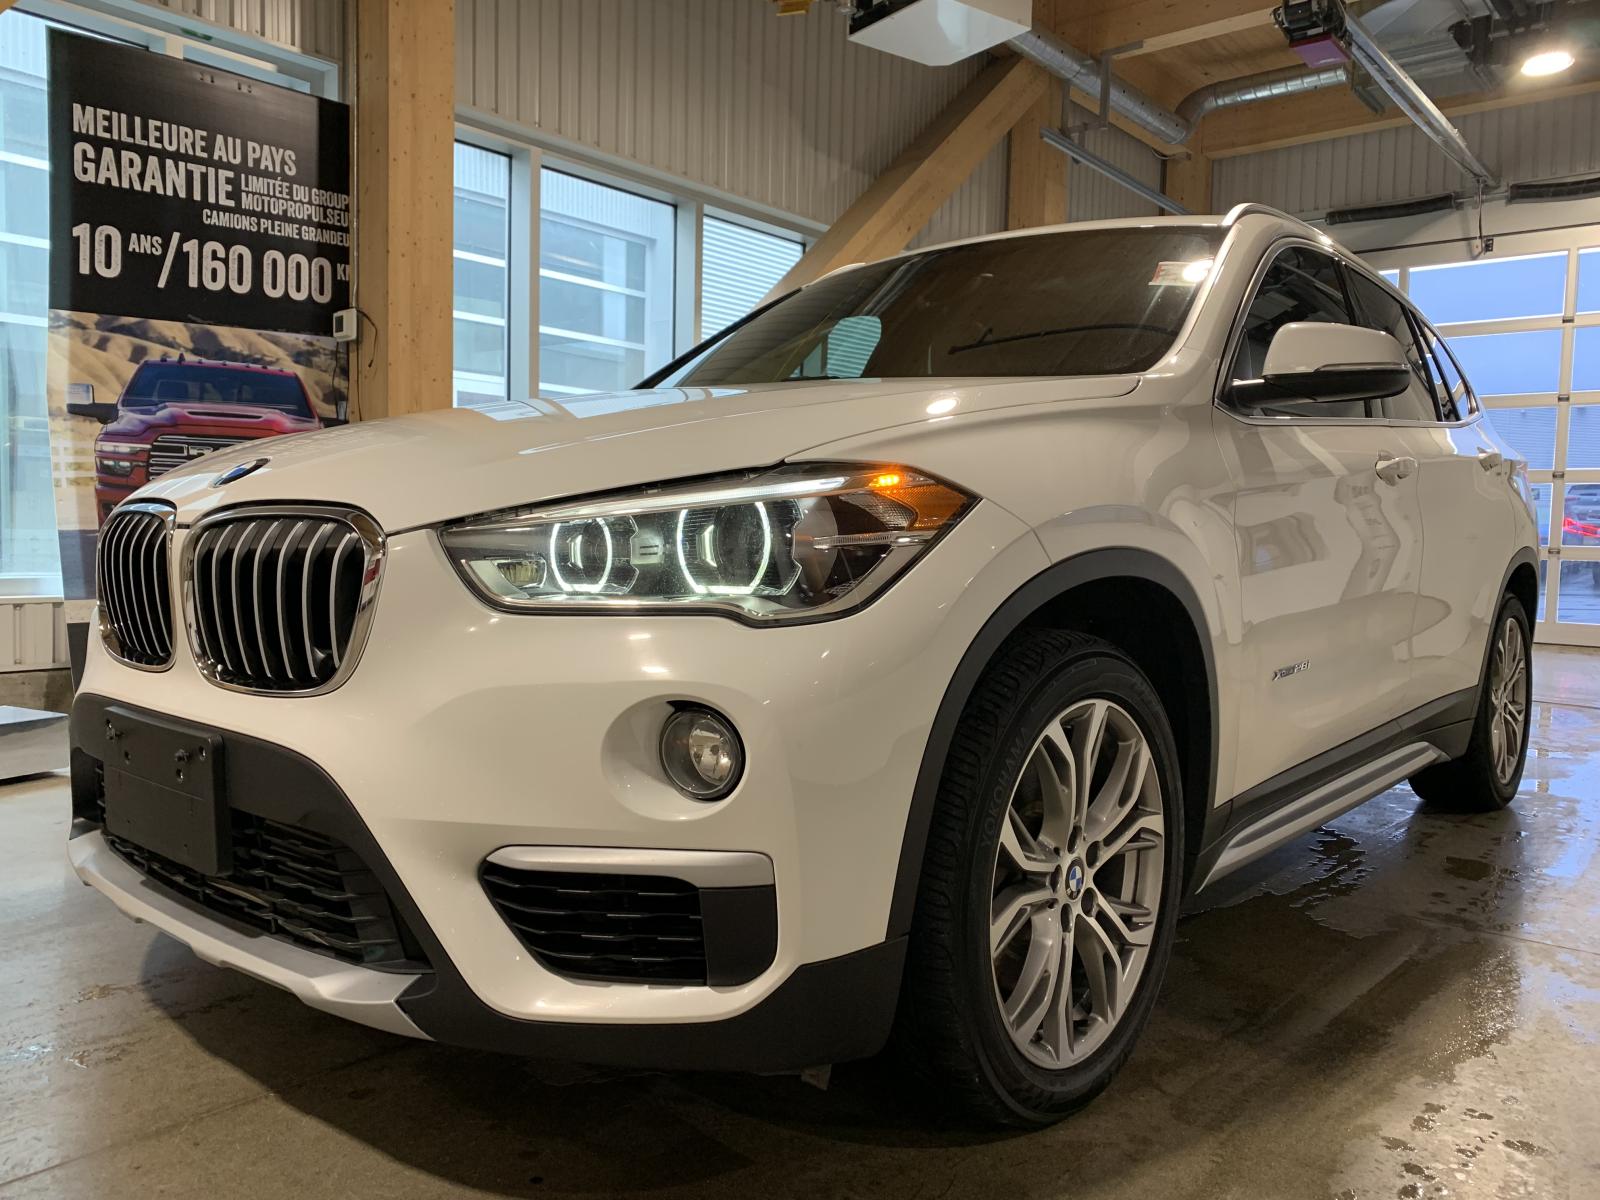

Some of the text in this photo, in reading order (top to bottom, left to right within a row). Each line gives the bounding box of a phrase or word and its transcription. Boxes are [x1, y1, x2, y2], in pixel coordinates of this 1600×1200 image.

[72, 102, 298, 176] MEILLEURE AU PAYS
[73, 141, 235, 208] GARANTIE
[240, 173, 350, 210] LIMITÉE DU GROUP
[202, 208, 350, 248] CAMIONS PLEINE GRANDEU
[241, 192, 349, 228] MOTOPROPULSEU
[72, 222, 122, 279] 10
[263, 249, 333, 304] 000
